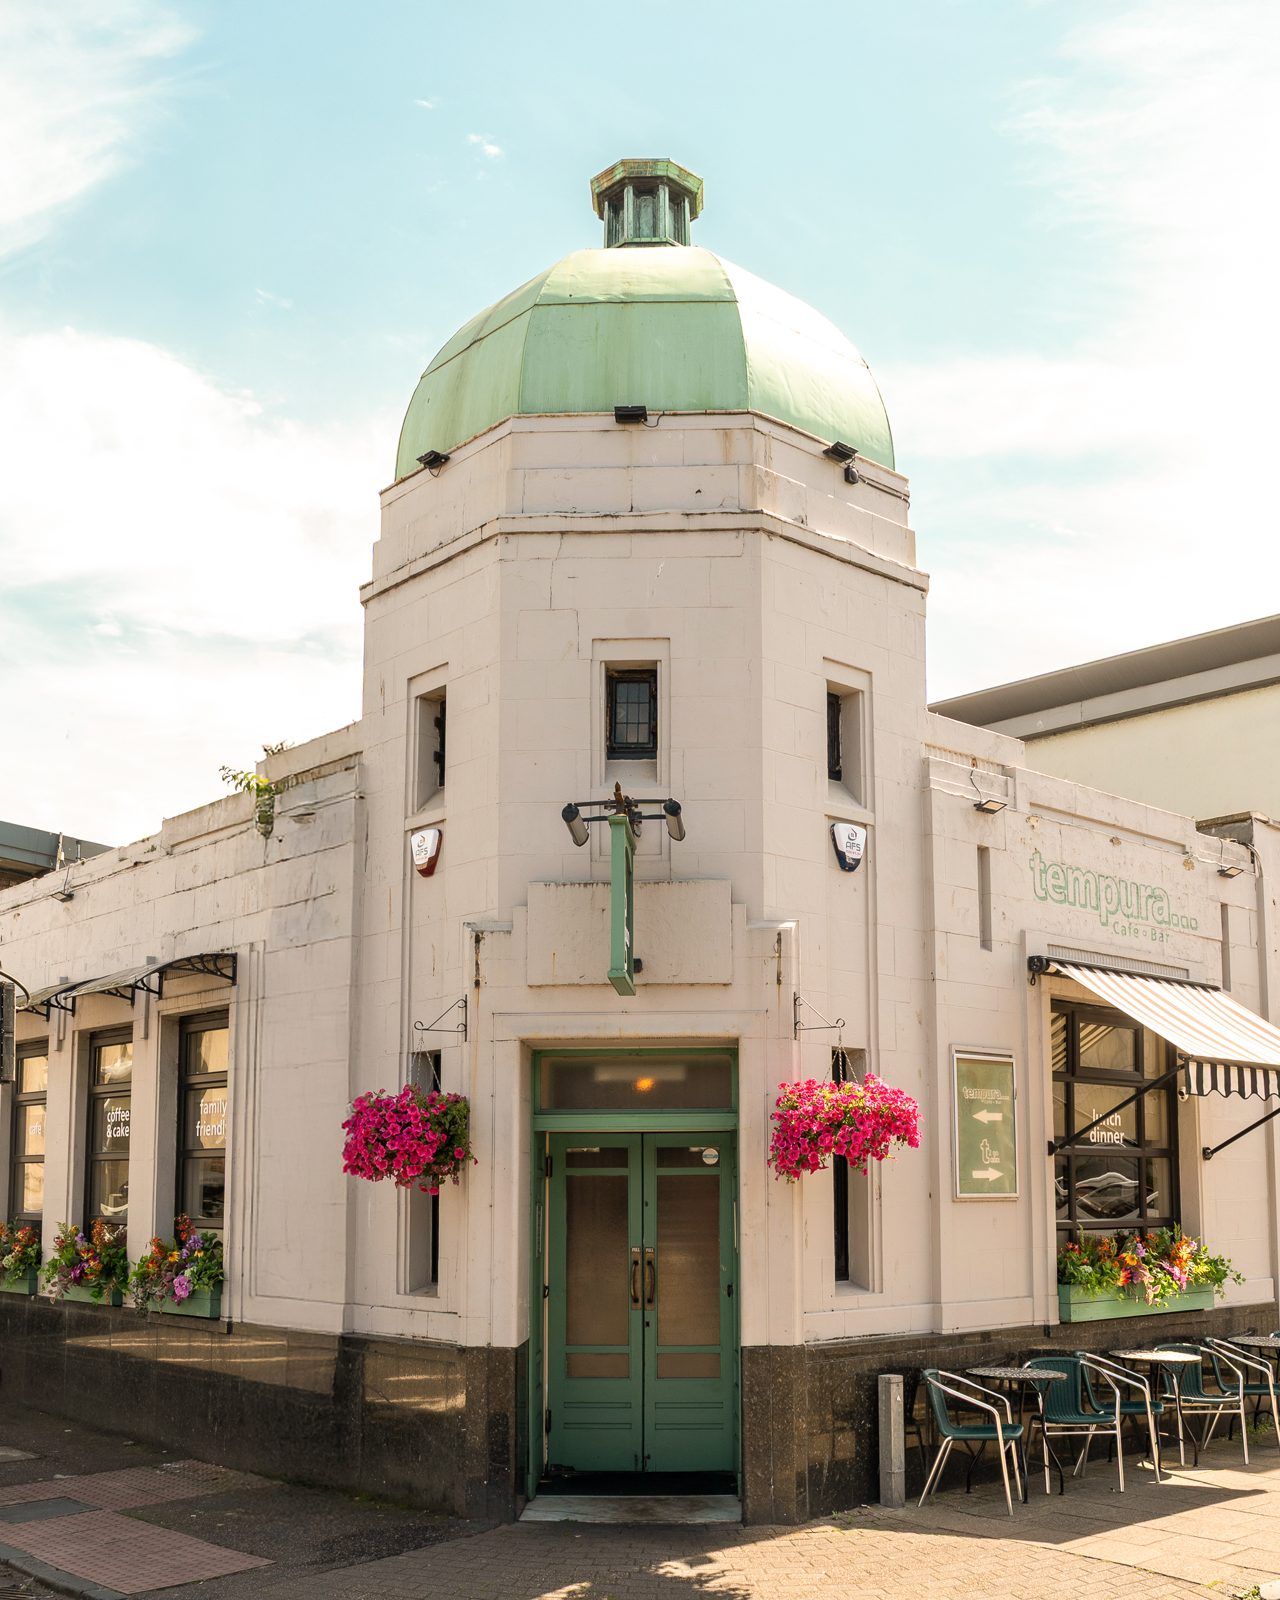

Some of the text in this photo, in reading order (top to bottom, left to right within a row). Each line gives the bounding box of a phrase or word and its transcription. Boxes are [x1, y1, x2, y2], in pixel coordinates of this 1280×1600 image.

[845, 841, 861, 852] AFS
[1151, 928, 1170, 943] Bar
[107, 1107, 130, 1122] coffee
[200, 1099, 227, 1118] family
[195, 1119, 227, 1139] friendl
[1090, 1126, 1125, 1144] dinner
